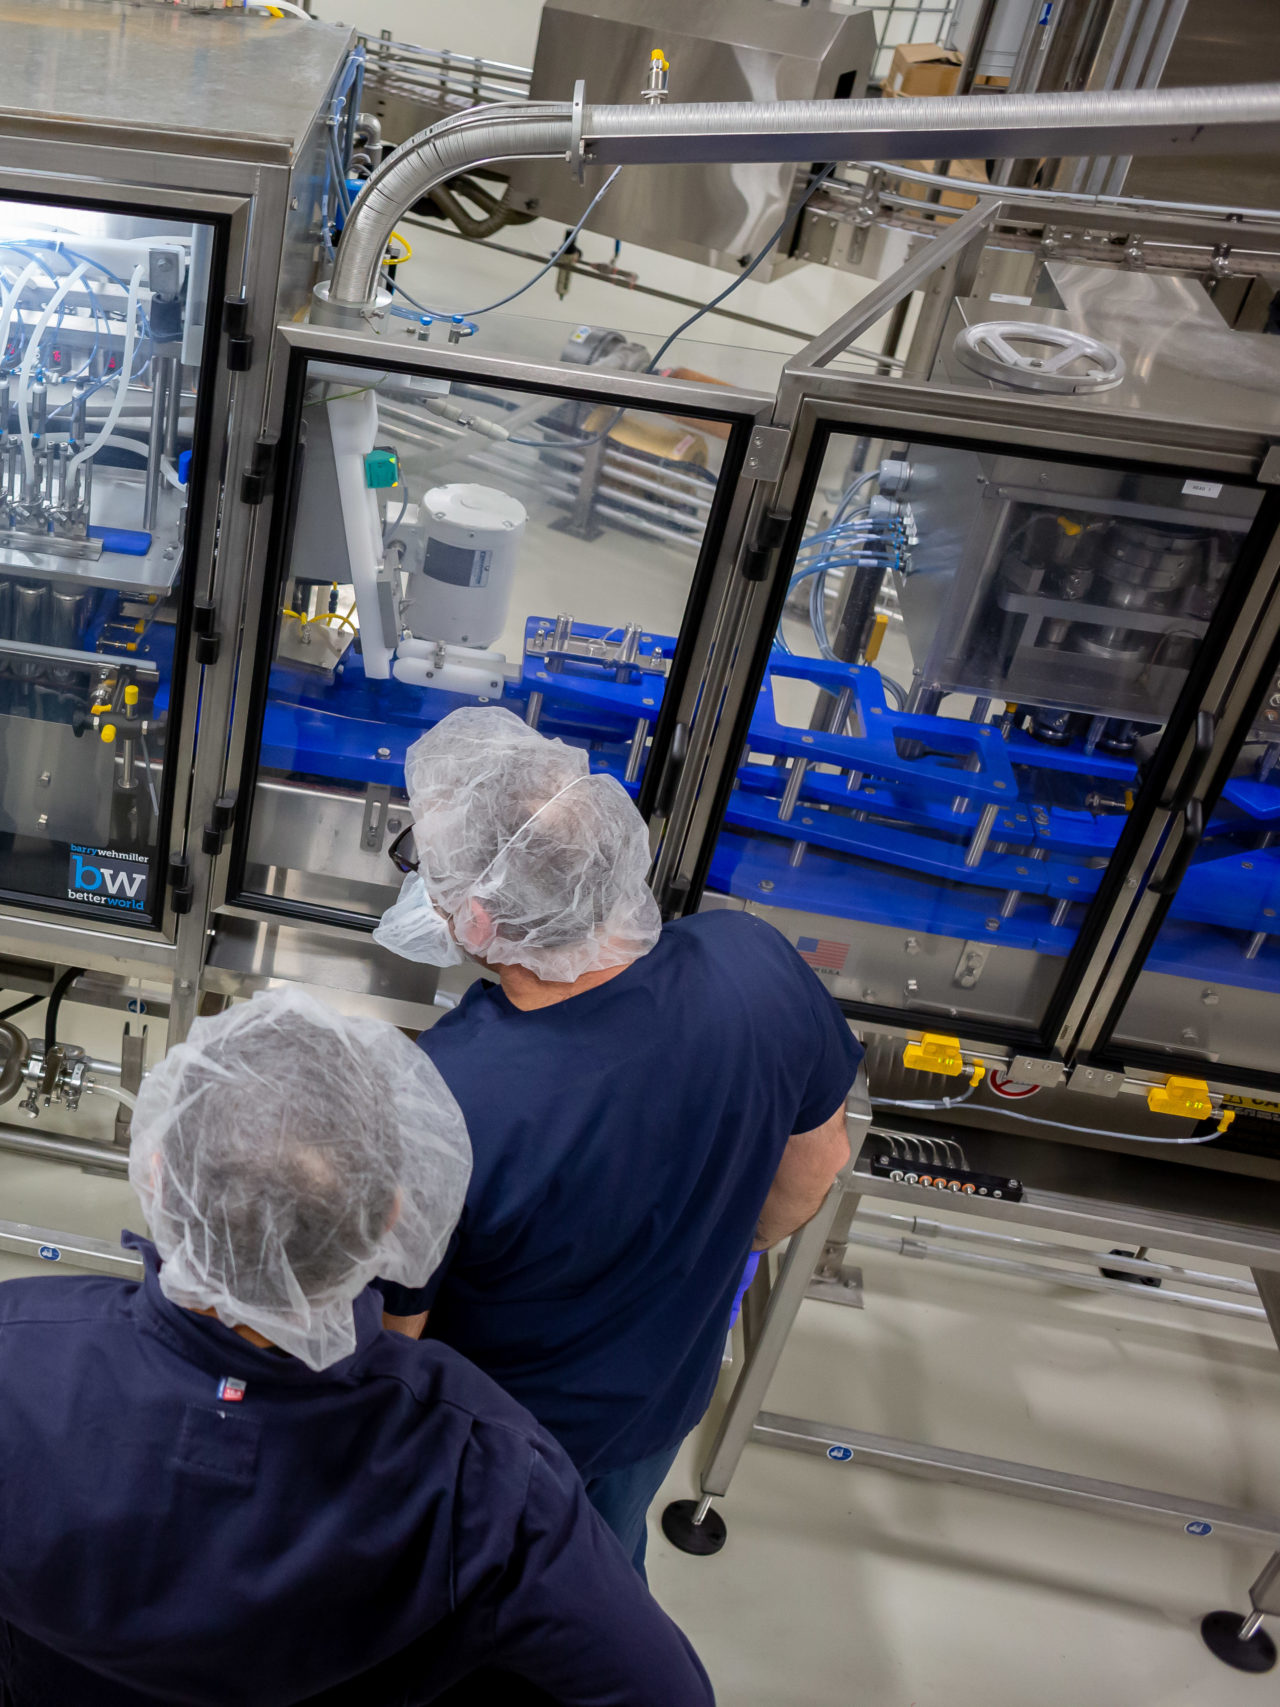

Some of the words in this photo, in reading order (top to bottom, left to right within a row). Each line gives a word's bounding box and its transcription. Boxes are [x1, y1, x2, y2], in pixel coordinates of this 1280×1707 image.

[70, 843, 149, 863] barrywehmiller
[72, 854, 146, 897] bw
[68, 889, 144, 911] betterworld
